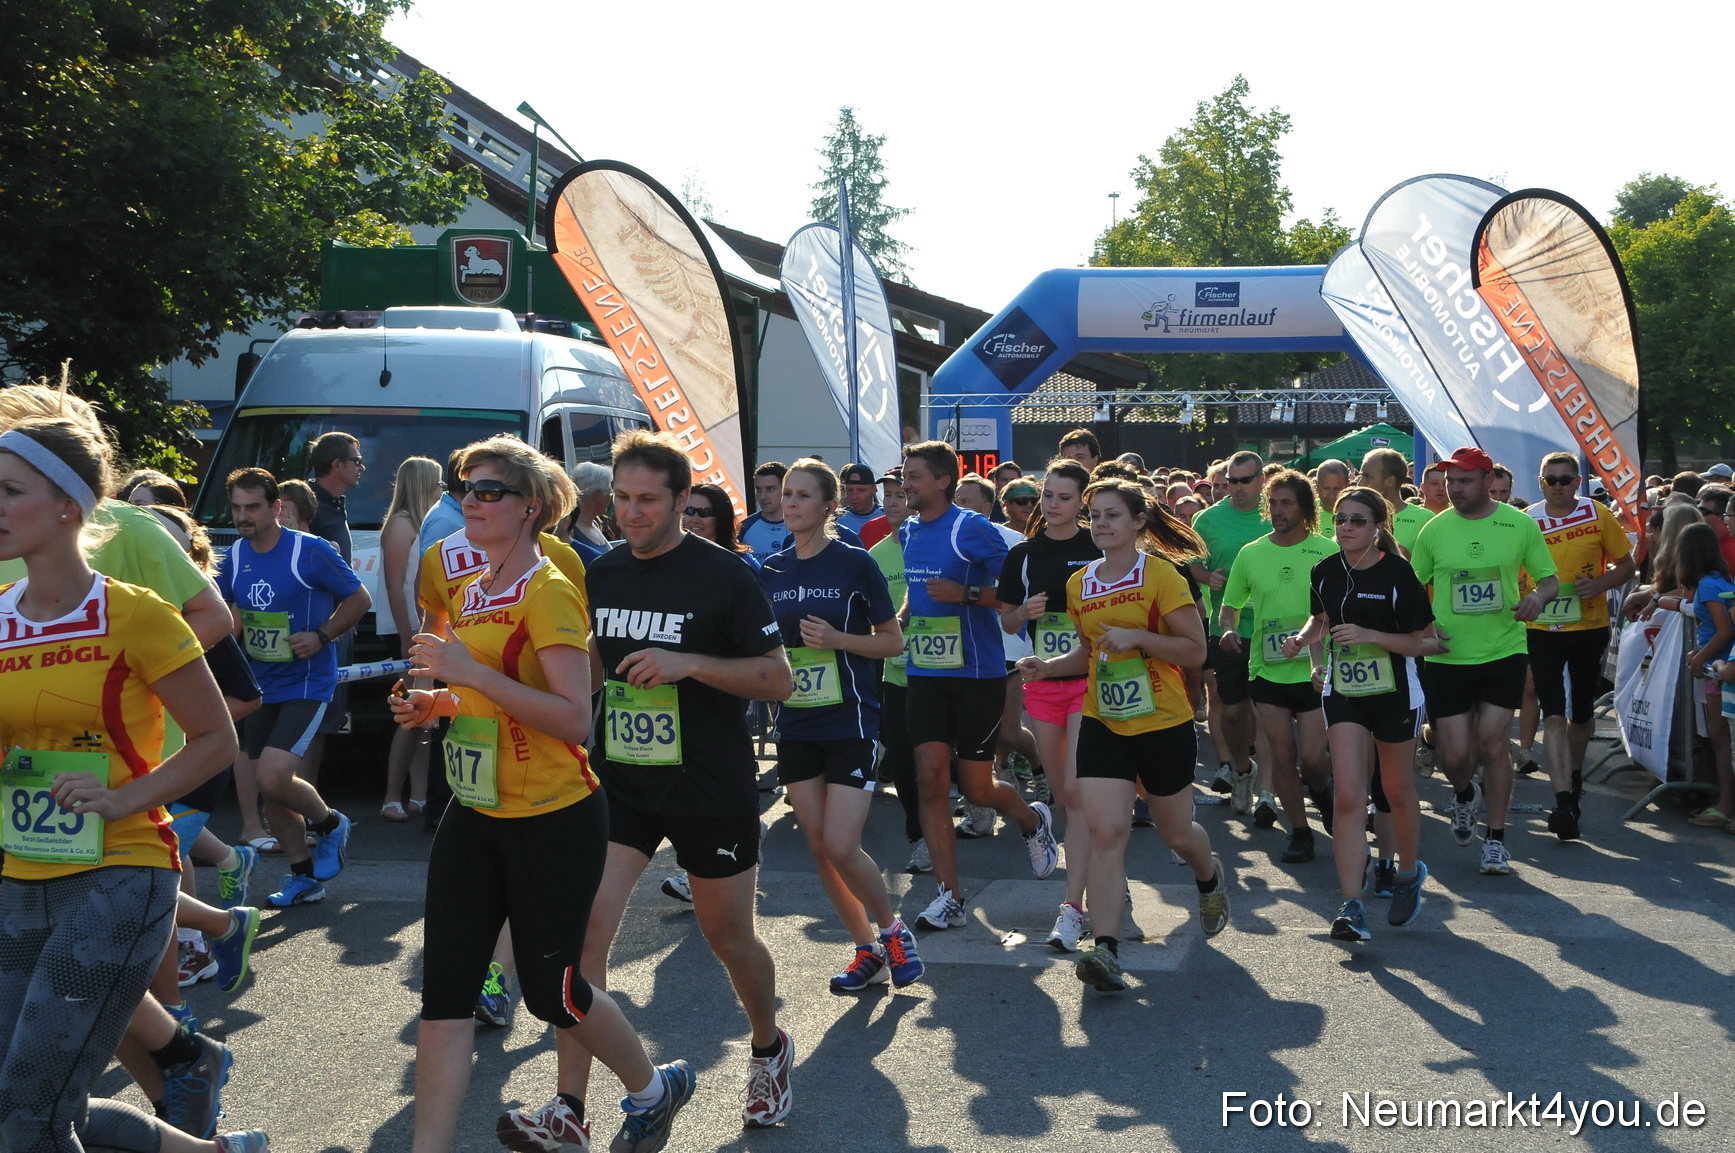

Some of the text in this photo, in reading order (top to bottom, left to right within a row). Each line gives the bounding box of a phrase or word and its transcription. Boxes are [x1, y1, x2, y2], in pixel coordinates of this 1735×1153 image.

[469, 289, 494, 299] 1628
[1204, 290, 1237, 299] Fischer
[1178, 307, 1278, 326] firmenlauf
[993, 342, 1045, 353] Fischer
[1545, 525, 1601, 545] AX BÖGL
[773, 588, 840, 602] EURO POLES
[1081, 592, 1145, 614] MAX BÖGL
[1458, 583, 1495, 603] 194
[596, 608, 685, 641] THULE
[247, 627, 280, 649] 287
[652, 633, 678, 641] SWEDEN
[911, 635, 959, 656] 1297
[41, 644, 110, 668] BÖGL
[793, 666, 826, 692] 37
[1340, 660, 1380, 684] 961
[1100, 680, 1143, 706] 802
[607, 709, 676, 745] 1393
[446, 742, 482, 784] 817
[12, 789, 84, 835] 825
